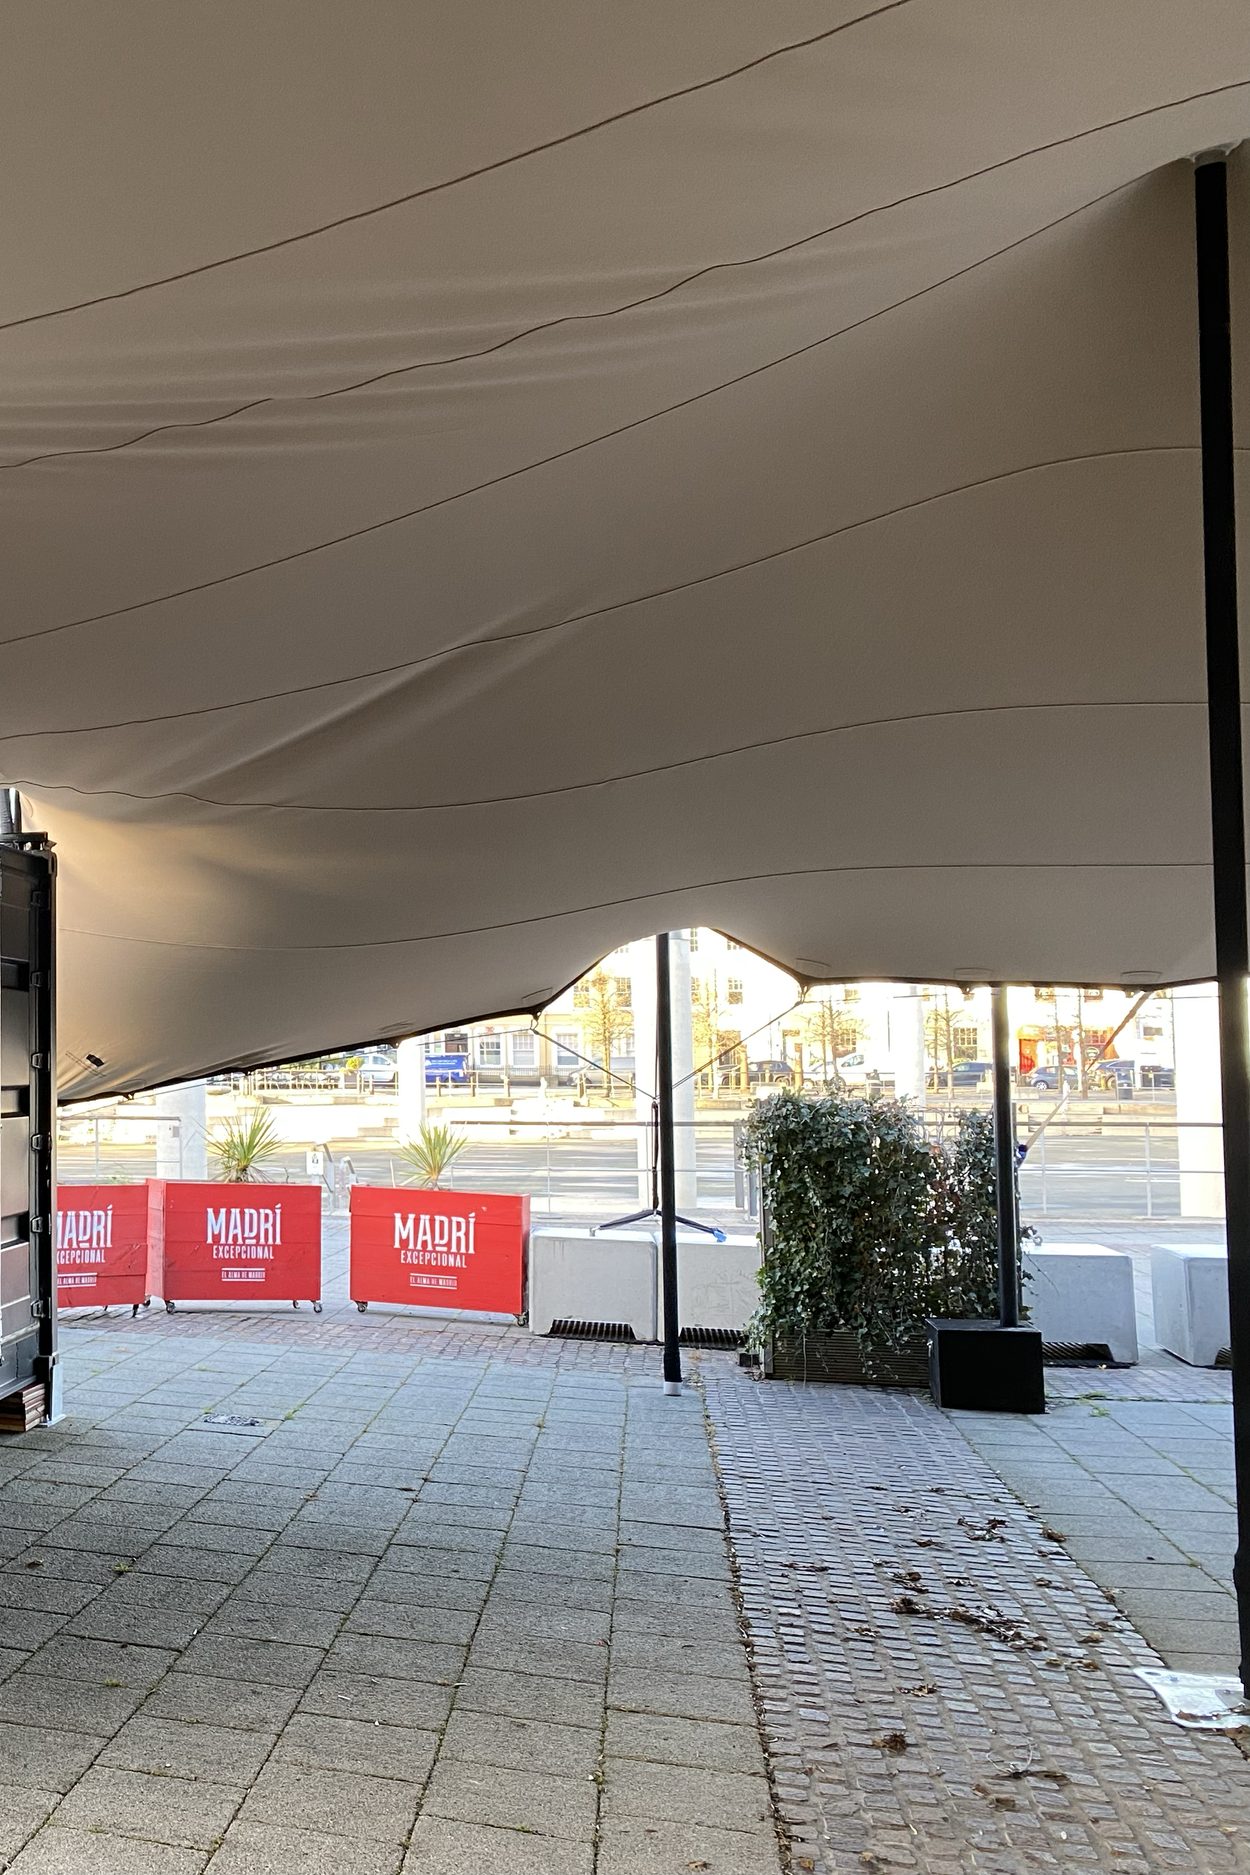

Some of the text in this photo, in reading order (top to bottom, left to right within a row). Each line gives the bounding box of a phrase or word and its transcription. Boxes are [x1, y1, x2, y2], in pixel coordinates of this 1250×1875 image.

[206, 1203, 282, 1245] MADRÍ
[393, 1212, 476, 1254] MADRÍ
[57, 1249, 105, 1265] XCEPCIONAL
[213, 1245, 274, 1259] EXCEPCIONAL
[400, 1250, 467, 1268] EXCEPCIONAL
